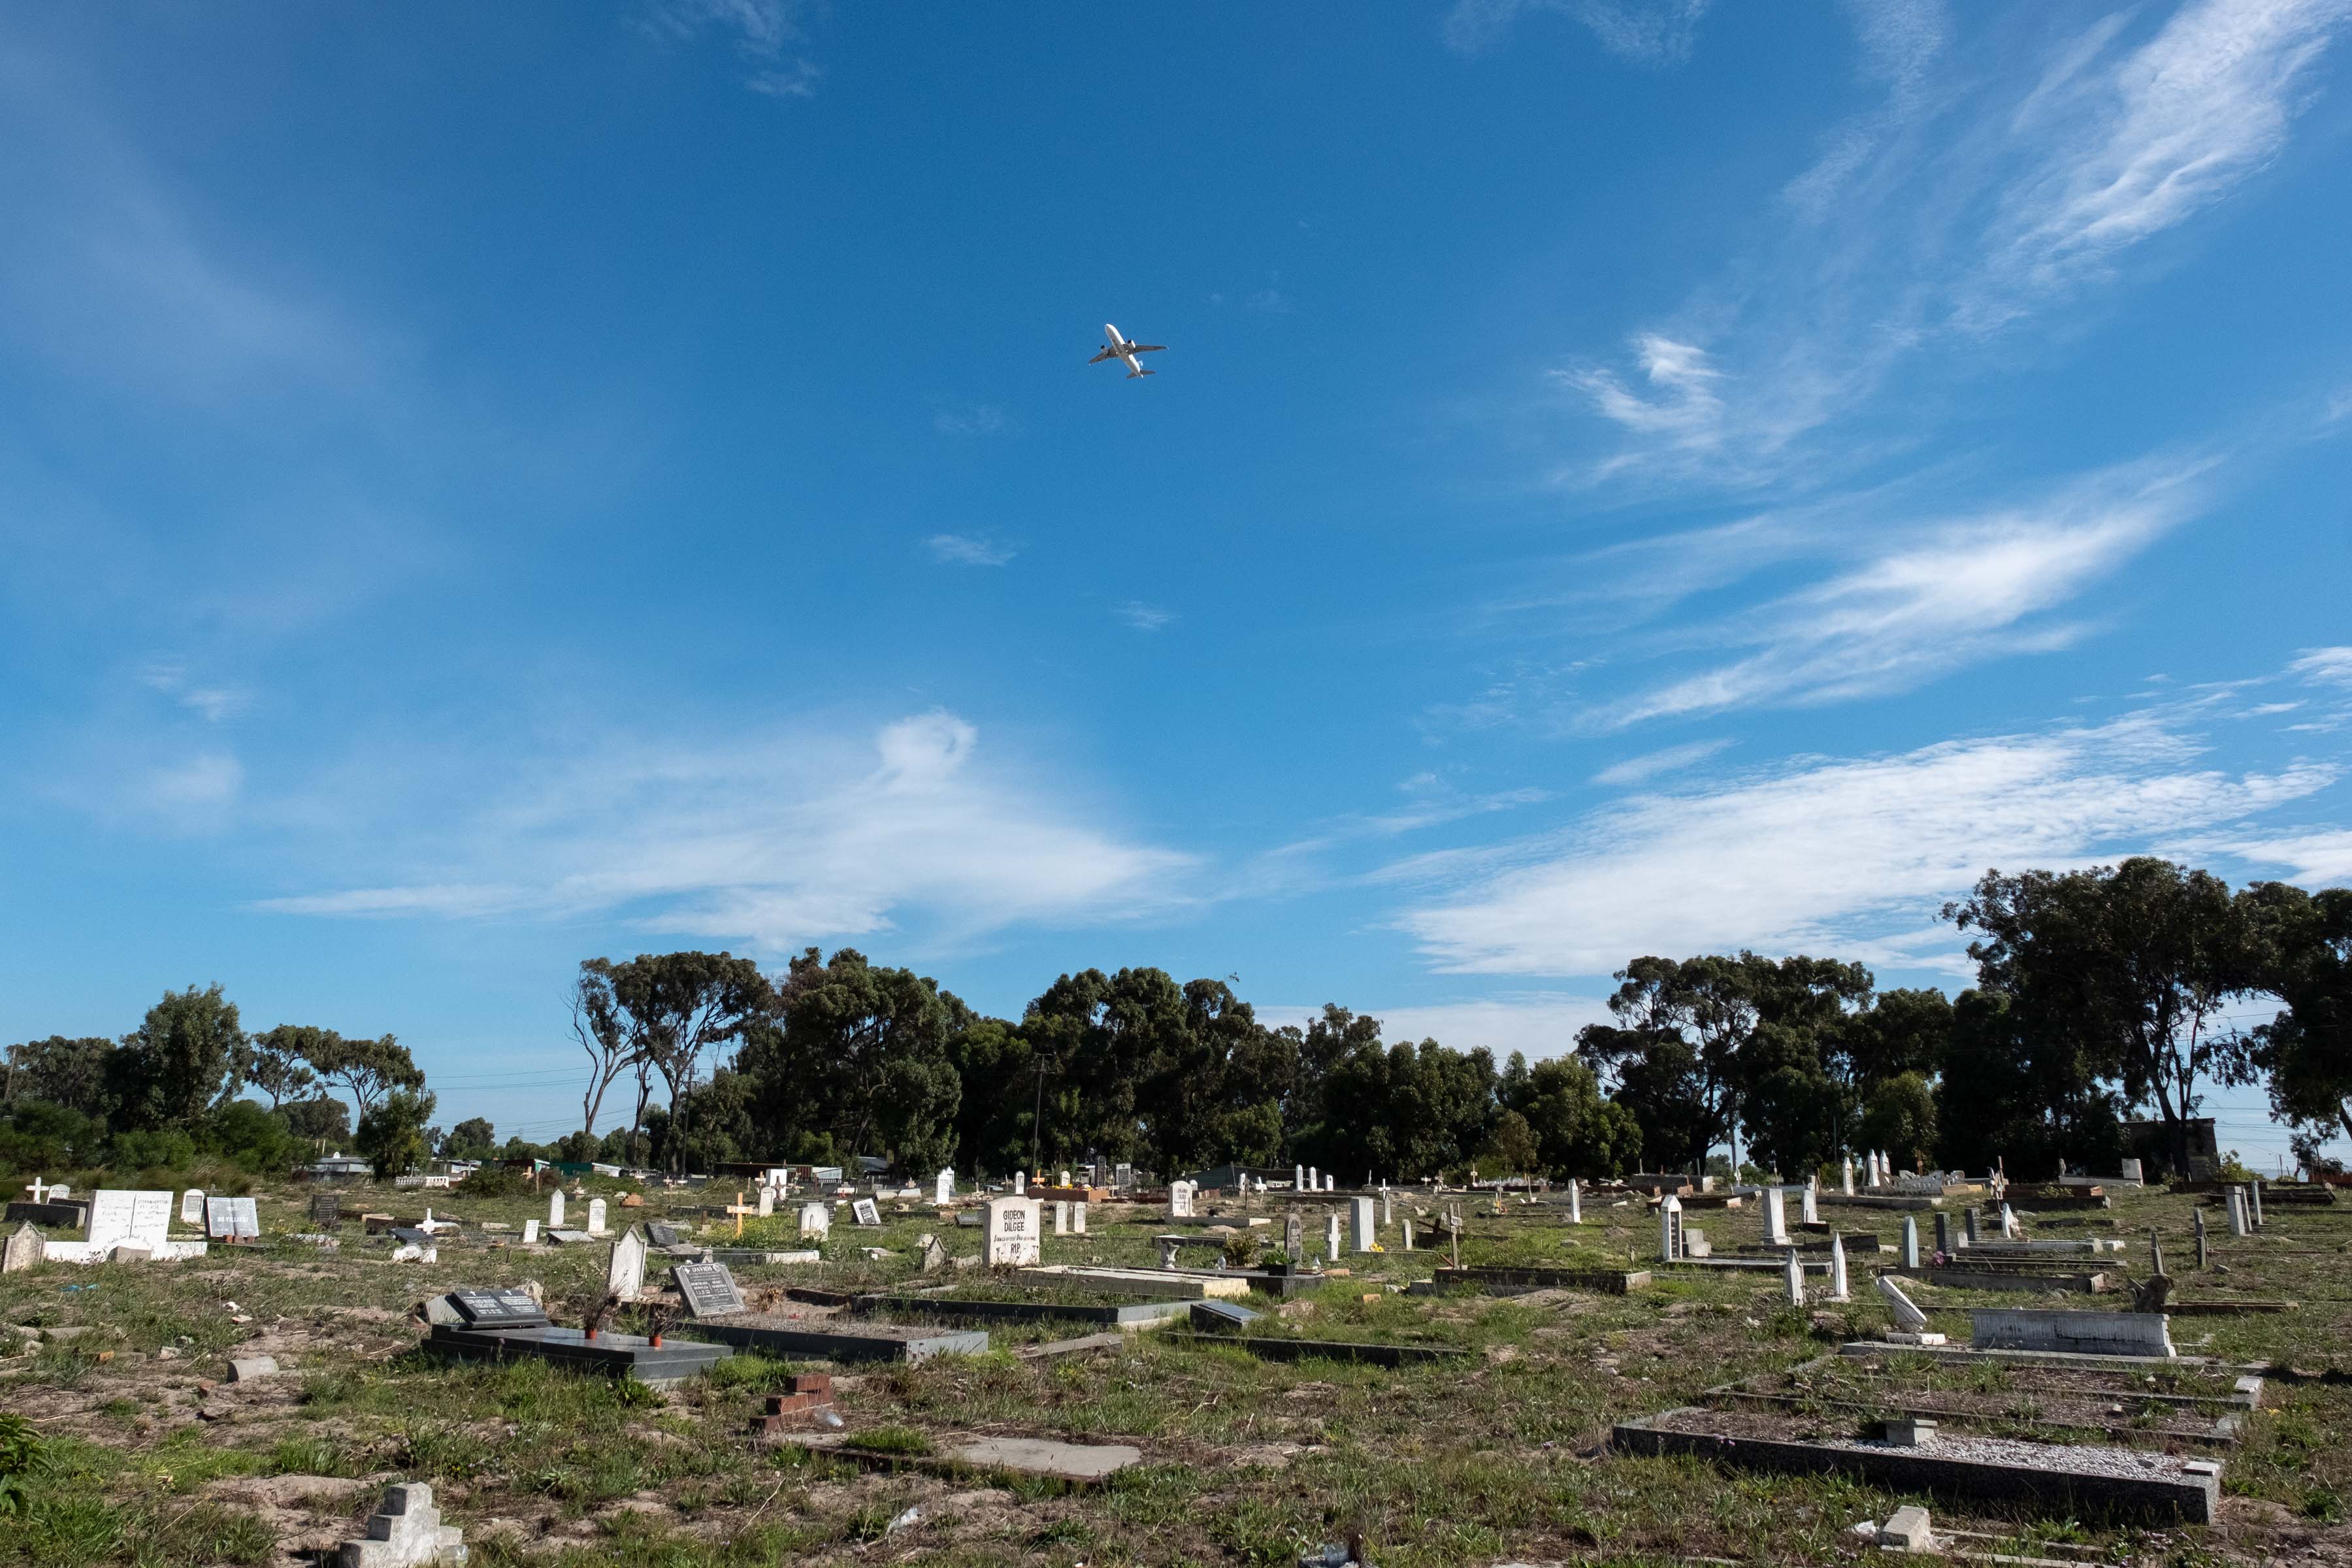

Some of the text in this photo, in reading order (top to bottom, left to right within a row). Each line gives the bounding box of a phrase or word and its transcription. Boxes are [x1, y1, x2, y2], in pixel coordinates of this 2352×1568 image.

[1003, 1210, 1025, 1220] GIDEON
[1004, 1222, 1024, 1232] DILGEE
[1011, 1243, 1021, 1253] RIP
